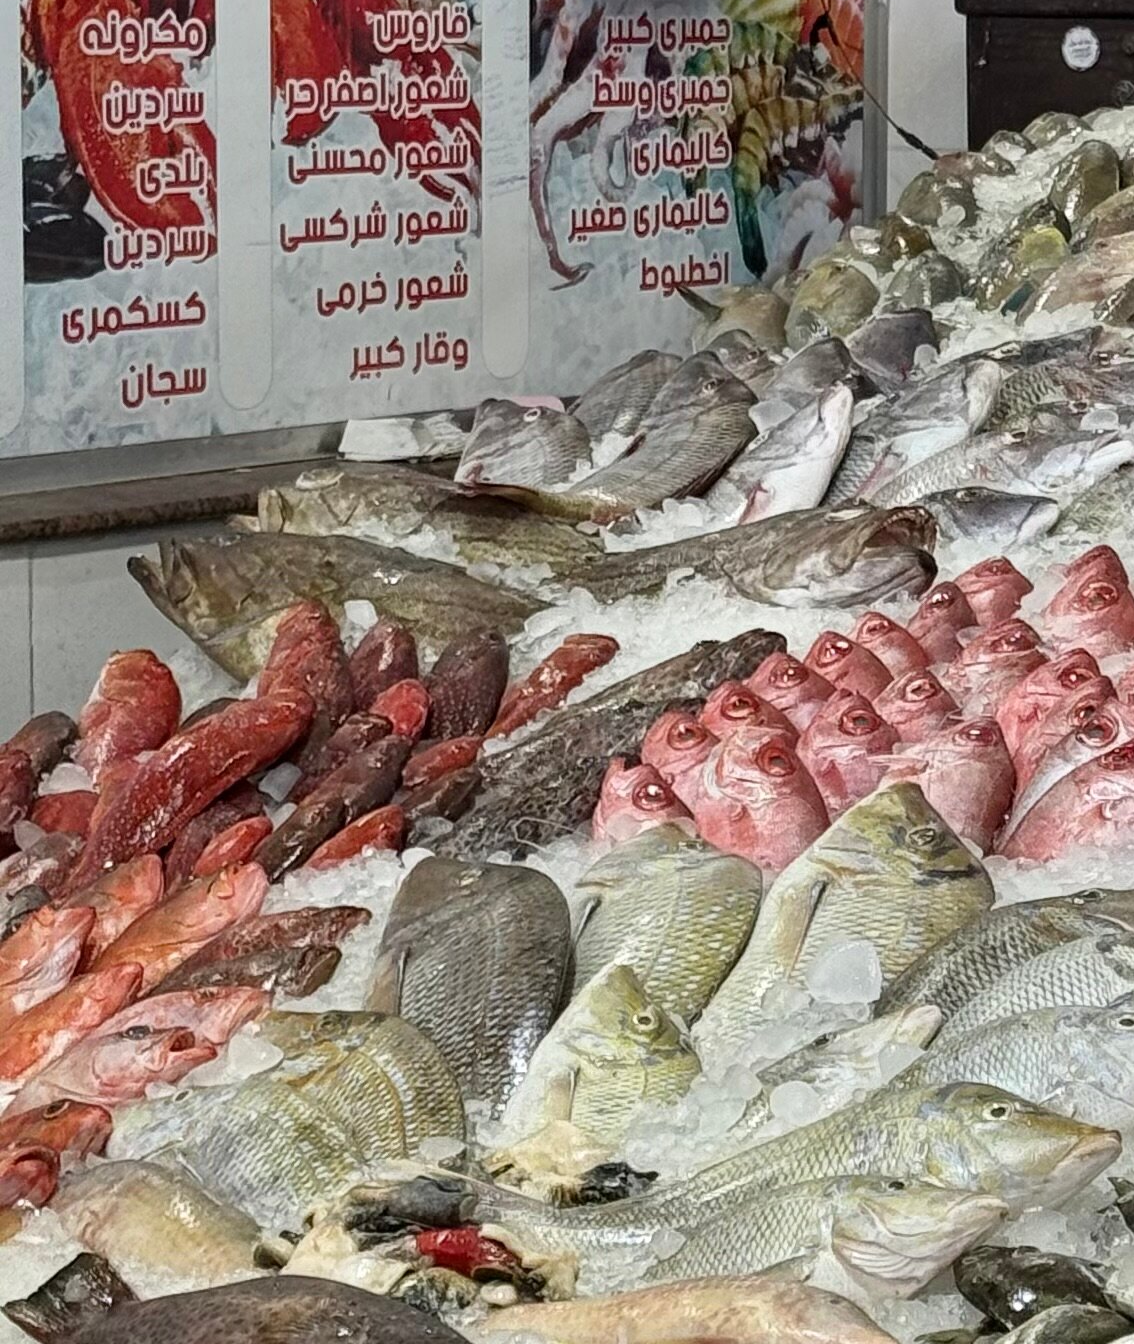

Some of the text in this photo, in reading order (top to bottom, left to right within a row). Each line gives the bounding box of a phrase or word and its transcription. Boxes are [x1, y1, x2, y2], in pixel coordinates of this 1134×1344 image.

[81, 10, 206, 56] مكرونه
[373, 6, 470, 53] قاروس
[603, 11, 731, 52] جمبرى كبير
[103, 82, 206, 133] سردين
[322, 69, 387, 117] اصفر
[393, 65, 469, 117] شعور
[592, 73, 732, 114] جمبرى وسط
[137, 149, 208, 203] بلدى
[393, 128, 469, 181] شعور
[632, 132, 731, 177] كاليمارى
[393, 195, 469, 246] شعور
[567, 192, 730, 243] كاليمارى صغير
[106, 226, 207, 269] سردين
[394, 260, 469, 312] شعور
[62, 291, 207, 344] كسكمرى
[349, 330, 470, 381] وقار كبير
[121, 363, 207, 409] سجان
